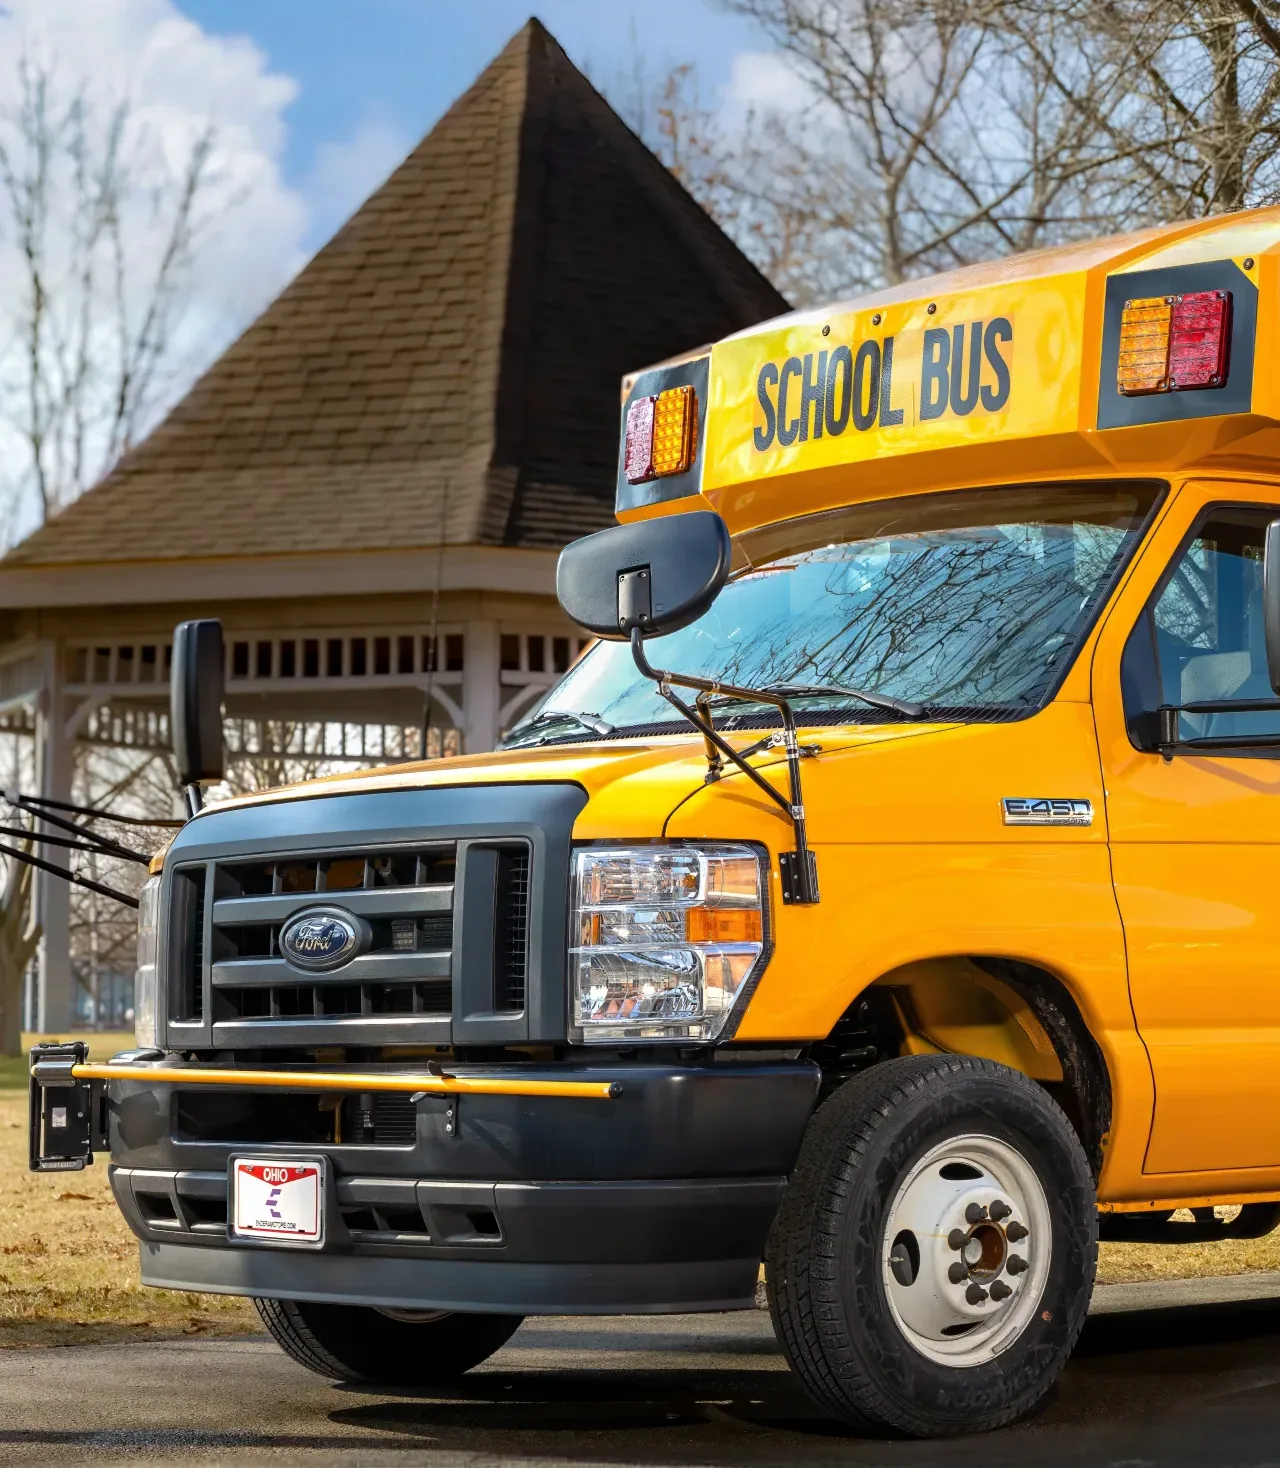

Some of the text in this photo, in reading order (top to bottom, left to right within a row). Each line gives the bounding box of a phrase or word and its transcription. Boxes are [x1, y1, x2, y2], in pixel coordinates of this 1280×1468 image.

[753, 317, 1013, 452] SCHOOL BUS
[295, 922, 333, 952] Ford
[263, 1167, 288, 1182] OHIO
